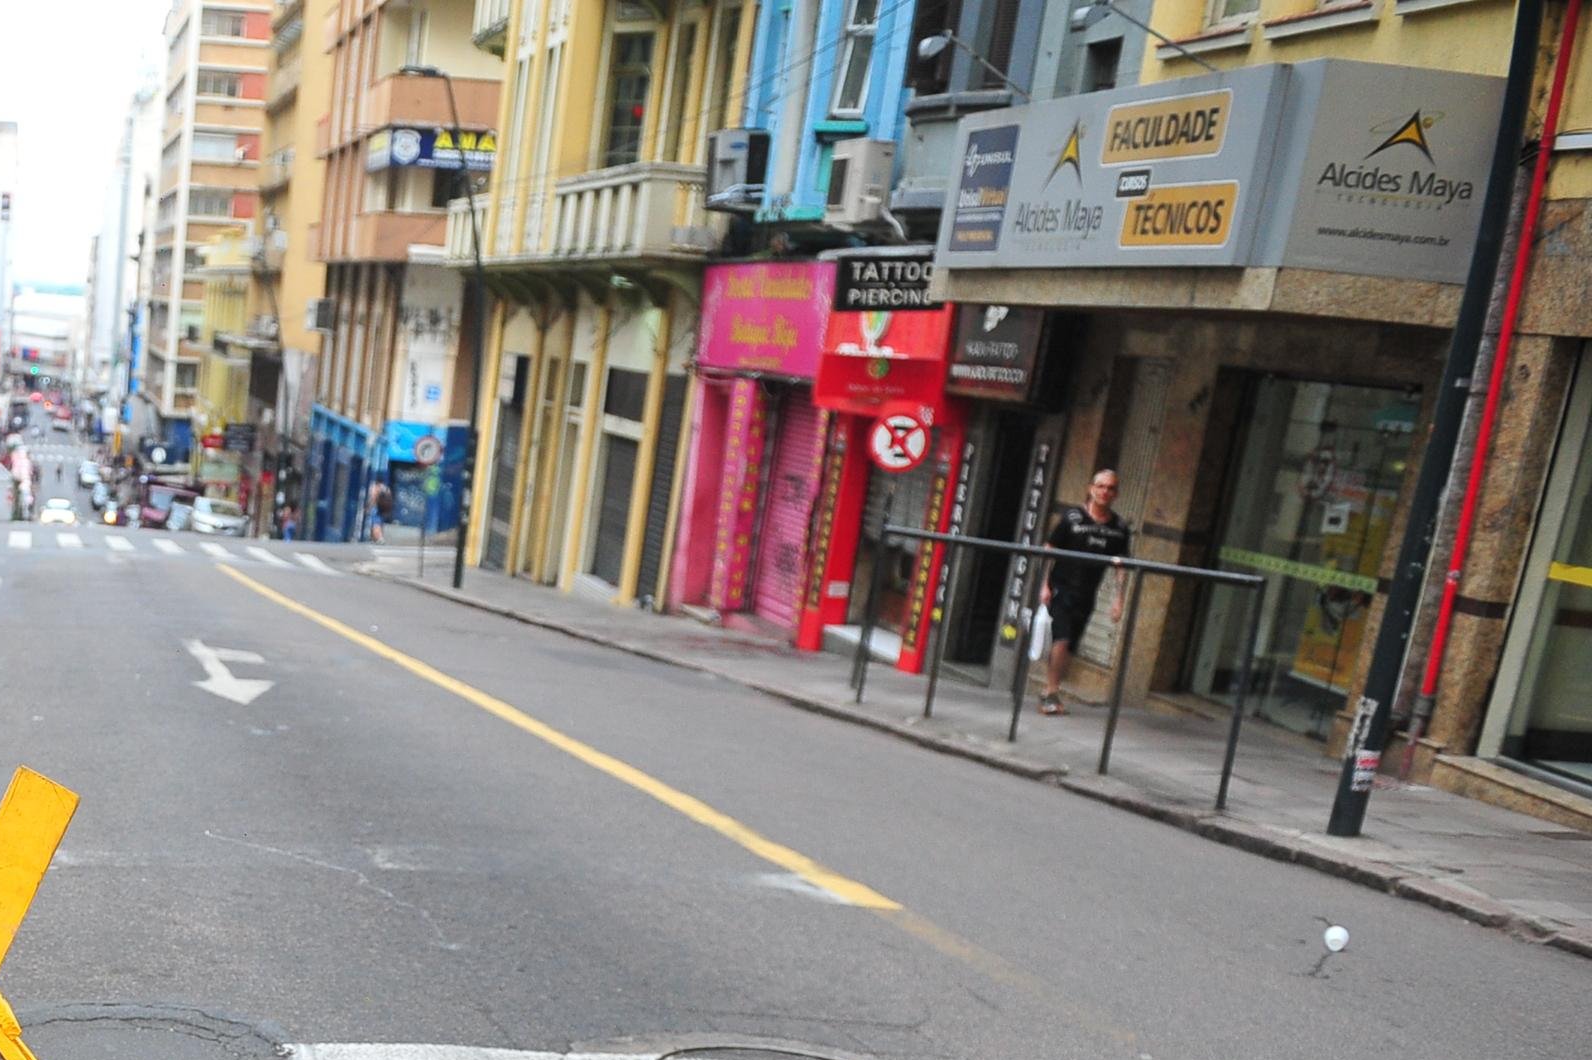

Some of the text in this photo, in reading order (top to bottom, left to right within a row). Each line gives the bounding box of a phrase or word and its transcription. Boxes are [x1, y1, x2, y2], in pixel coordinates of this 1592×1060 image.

[1110, 107, 1220, 152] FACULDADE
[1119, 175, 1148, 191] CURSOS
[1317, 162, 1474, 205] Alcides Maya
[1016, 199, 1104, 239] Alcides Maya
[1132, 191, 1226, 236] TÉCNICOS
[1317, 226, 1450, 247] www.alcidesmaya.com.br
[850, 261, 934, 282] TATTOO
